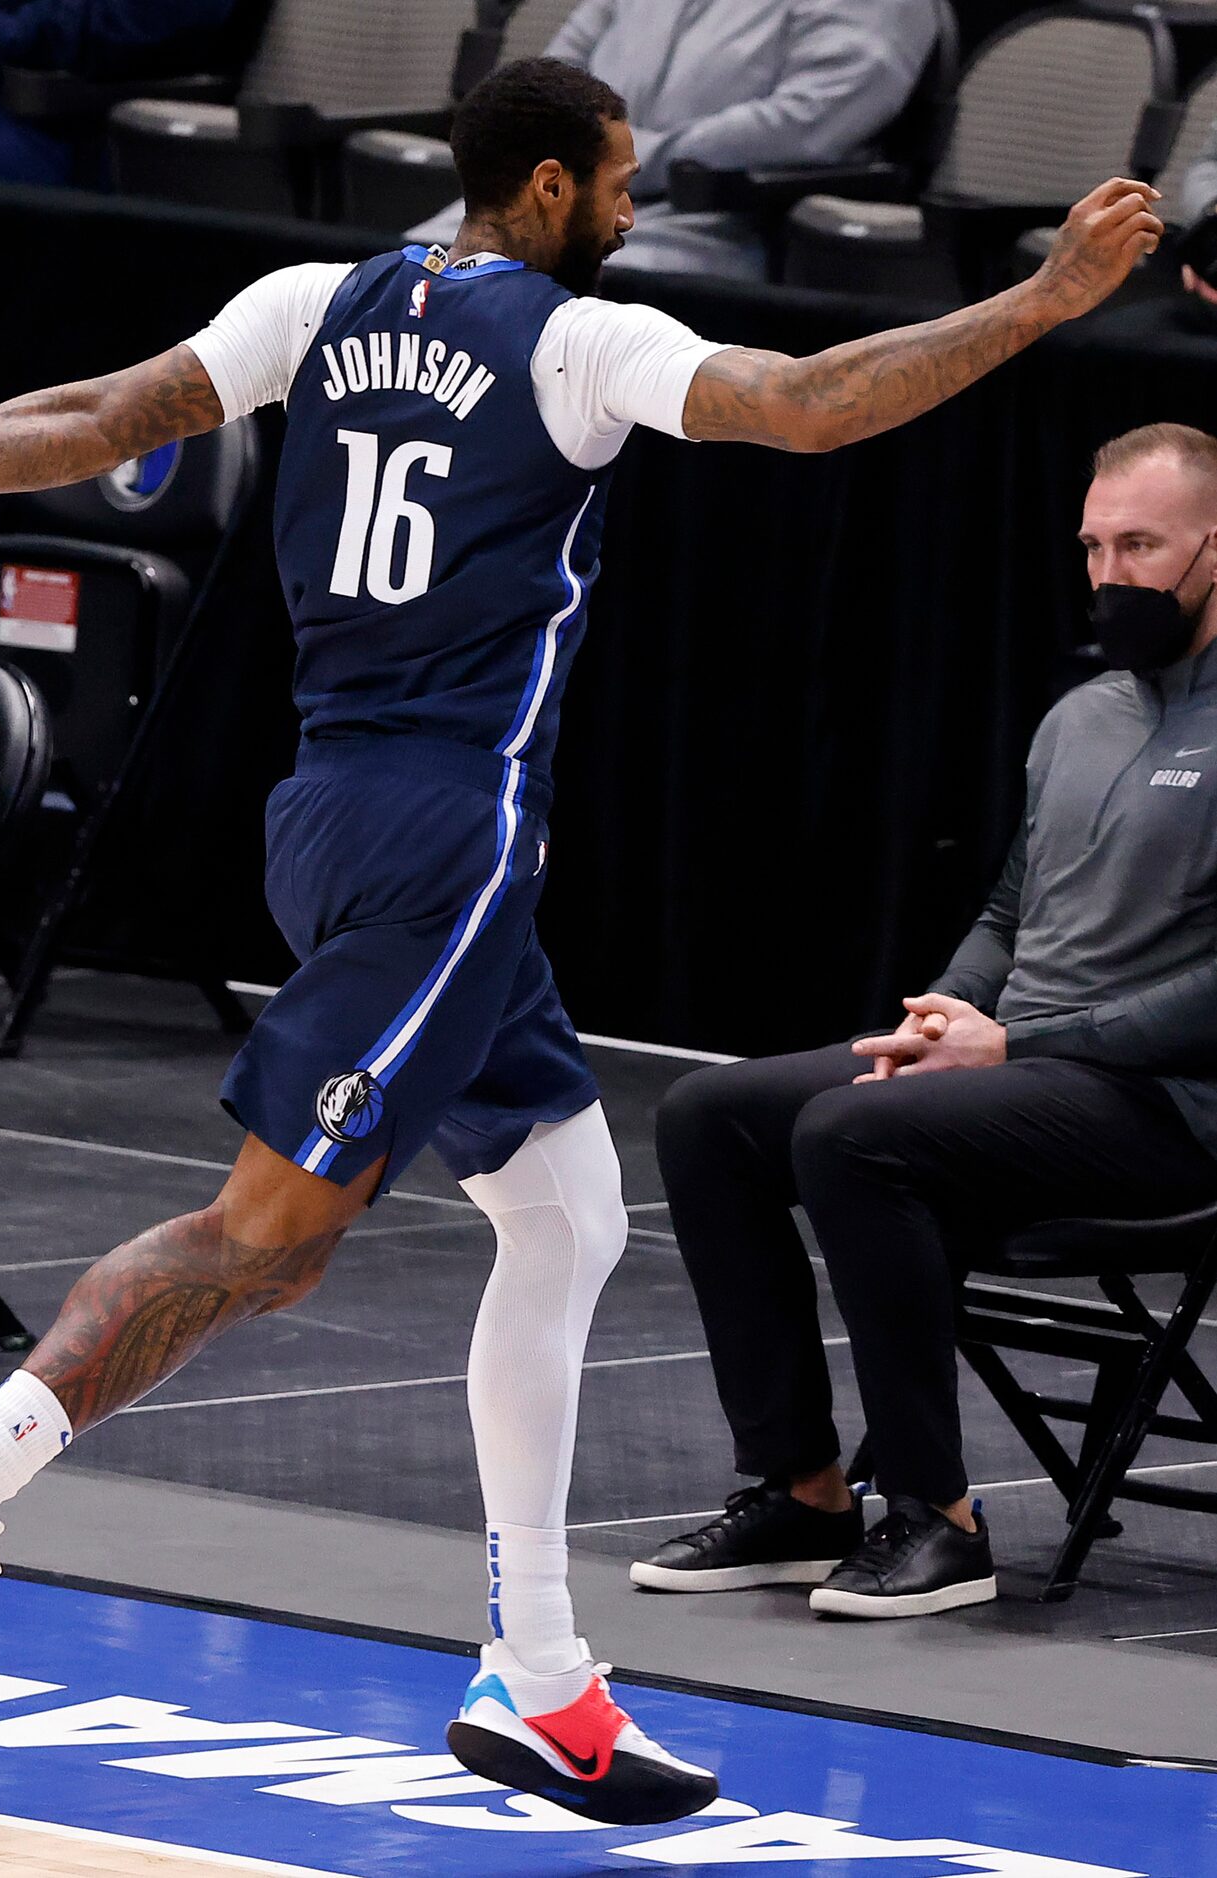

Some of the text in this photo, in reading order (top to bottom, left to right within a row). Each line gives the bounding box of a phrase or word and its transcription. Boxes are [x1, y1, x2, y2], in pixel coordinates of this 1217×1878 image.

[322, 332, 496, 421] JOHNSON
[329, 428, 453, 605] 16
[1149, 769, 1201, 788] DALLAS
